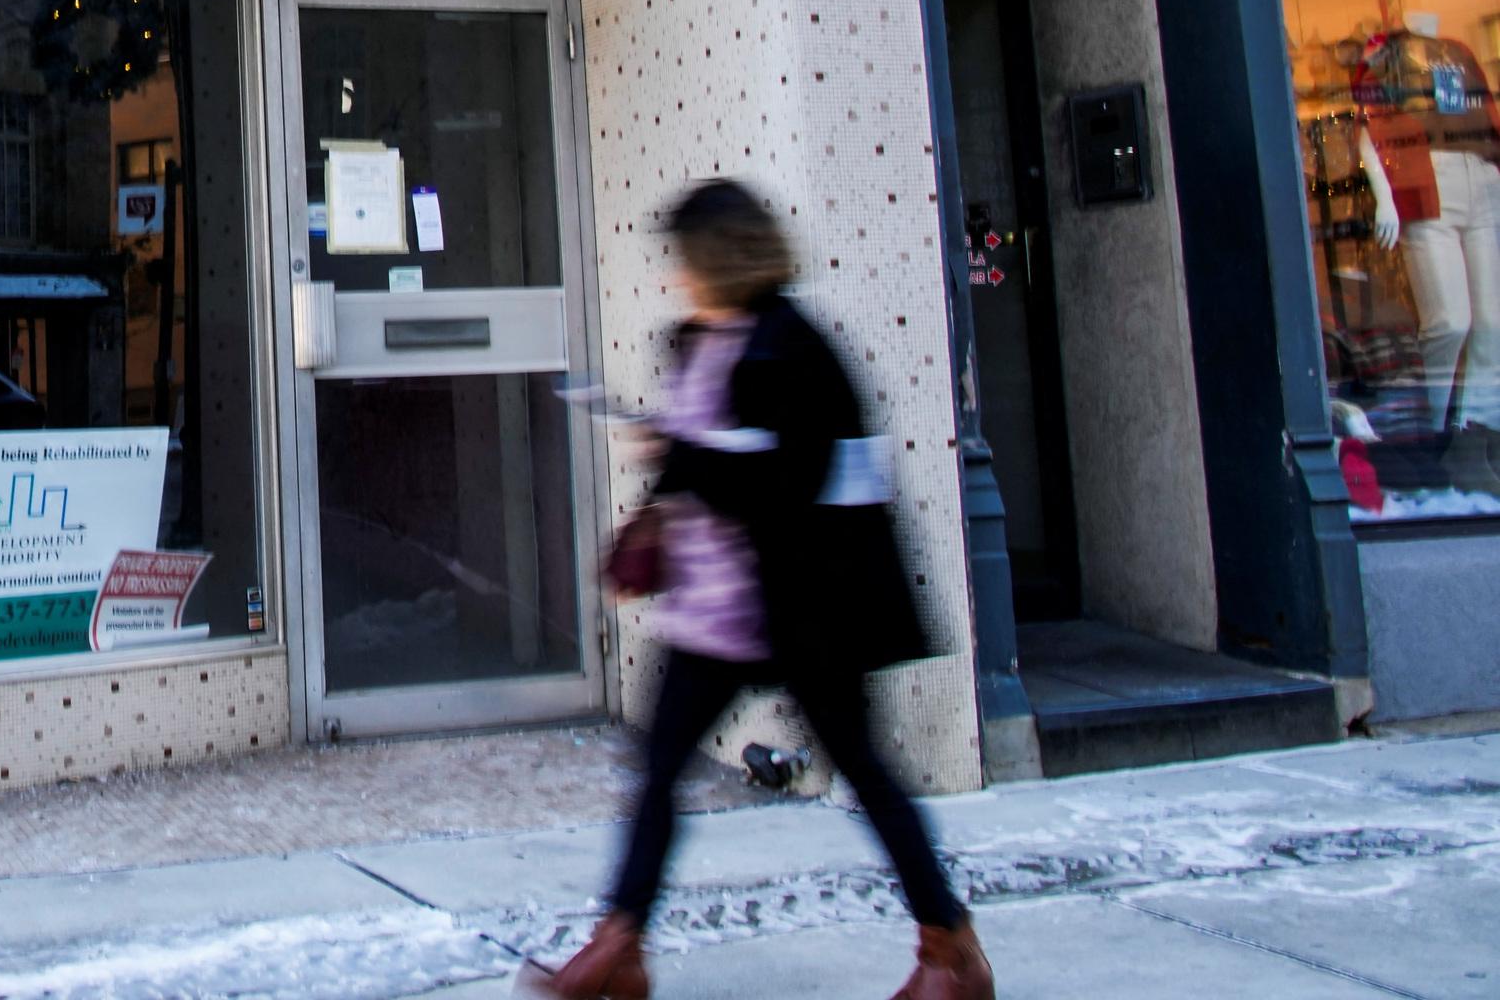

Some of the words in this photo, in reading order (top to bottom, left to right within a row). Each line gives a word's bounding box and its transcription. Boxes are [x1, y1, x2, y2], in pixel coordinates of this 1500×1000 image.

[1, 446, 38, 465] being
[43, 445, 132, 462] Rehabilitated
[136, 444, 151, 462] by
[56, 569, 101, 584] contact
